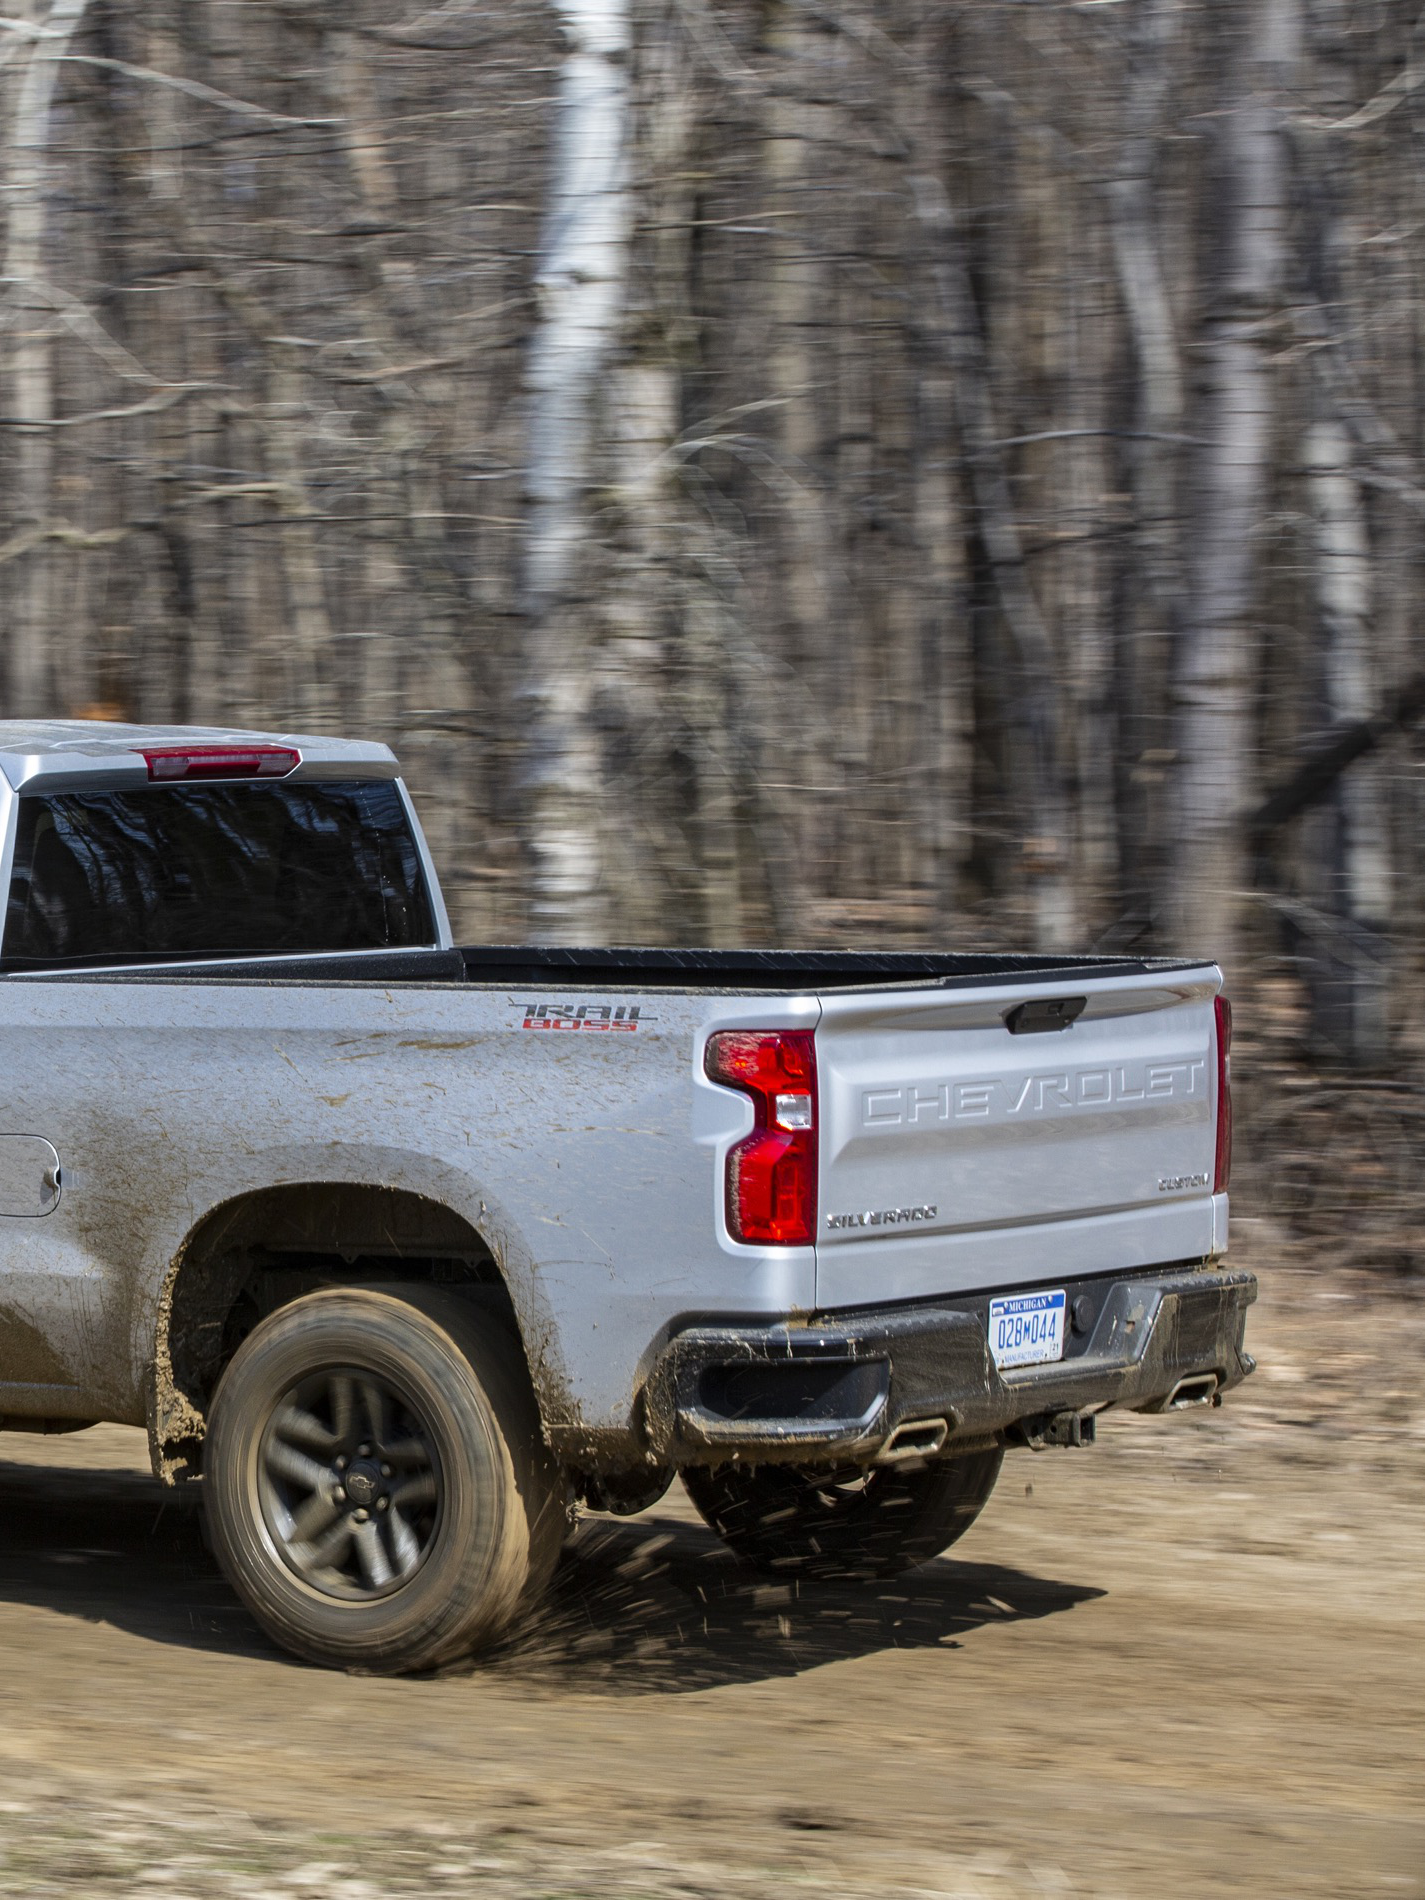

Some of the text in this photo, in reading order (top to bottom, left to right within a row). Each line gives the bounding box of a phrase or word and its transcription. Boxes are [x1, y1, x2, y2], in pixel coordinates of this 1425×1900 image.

[507, 996, 658, 1021] TRAIL
[522, 1018, 639, 1032] BOSS
[862, 1058, 1205, 1126] CHEVROLET
[1158, 1173, 1211, 1191] CUSTOM
[827, 1205, 937, 1229] SILVERADO
[1009, 1297, 1047, 1312] MICHIGAN
[998, 1311, 1056, 1349] 028M044
[1004, 1349, 1045, 1363] MANUFACTURER
